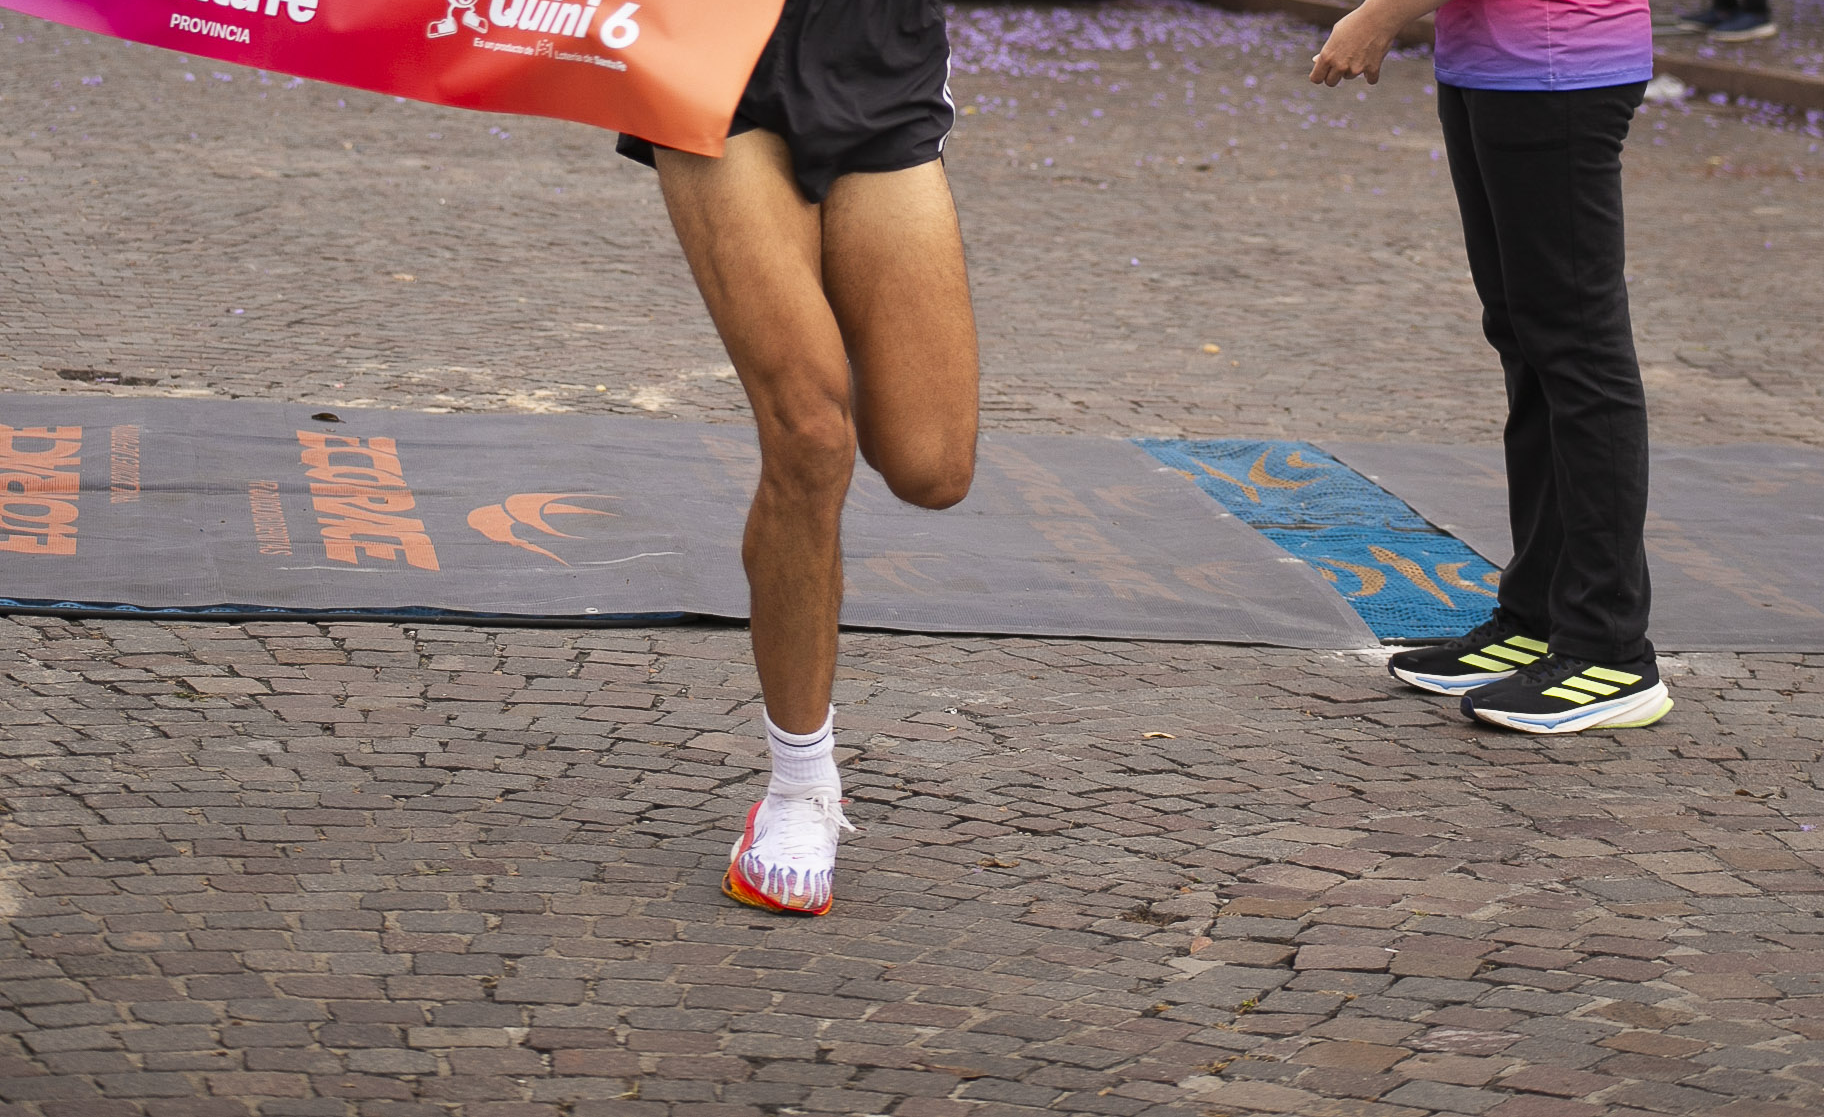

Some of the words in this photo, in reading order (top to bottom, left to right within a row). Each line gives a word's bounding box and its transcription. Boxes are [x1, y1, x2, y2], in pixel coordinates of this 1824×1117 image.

[169, 13, 251, 44] PROVINCIA
[600, 2, 641, 49] 6
[473, 37, 483, 48] Es
